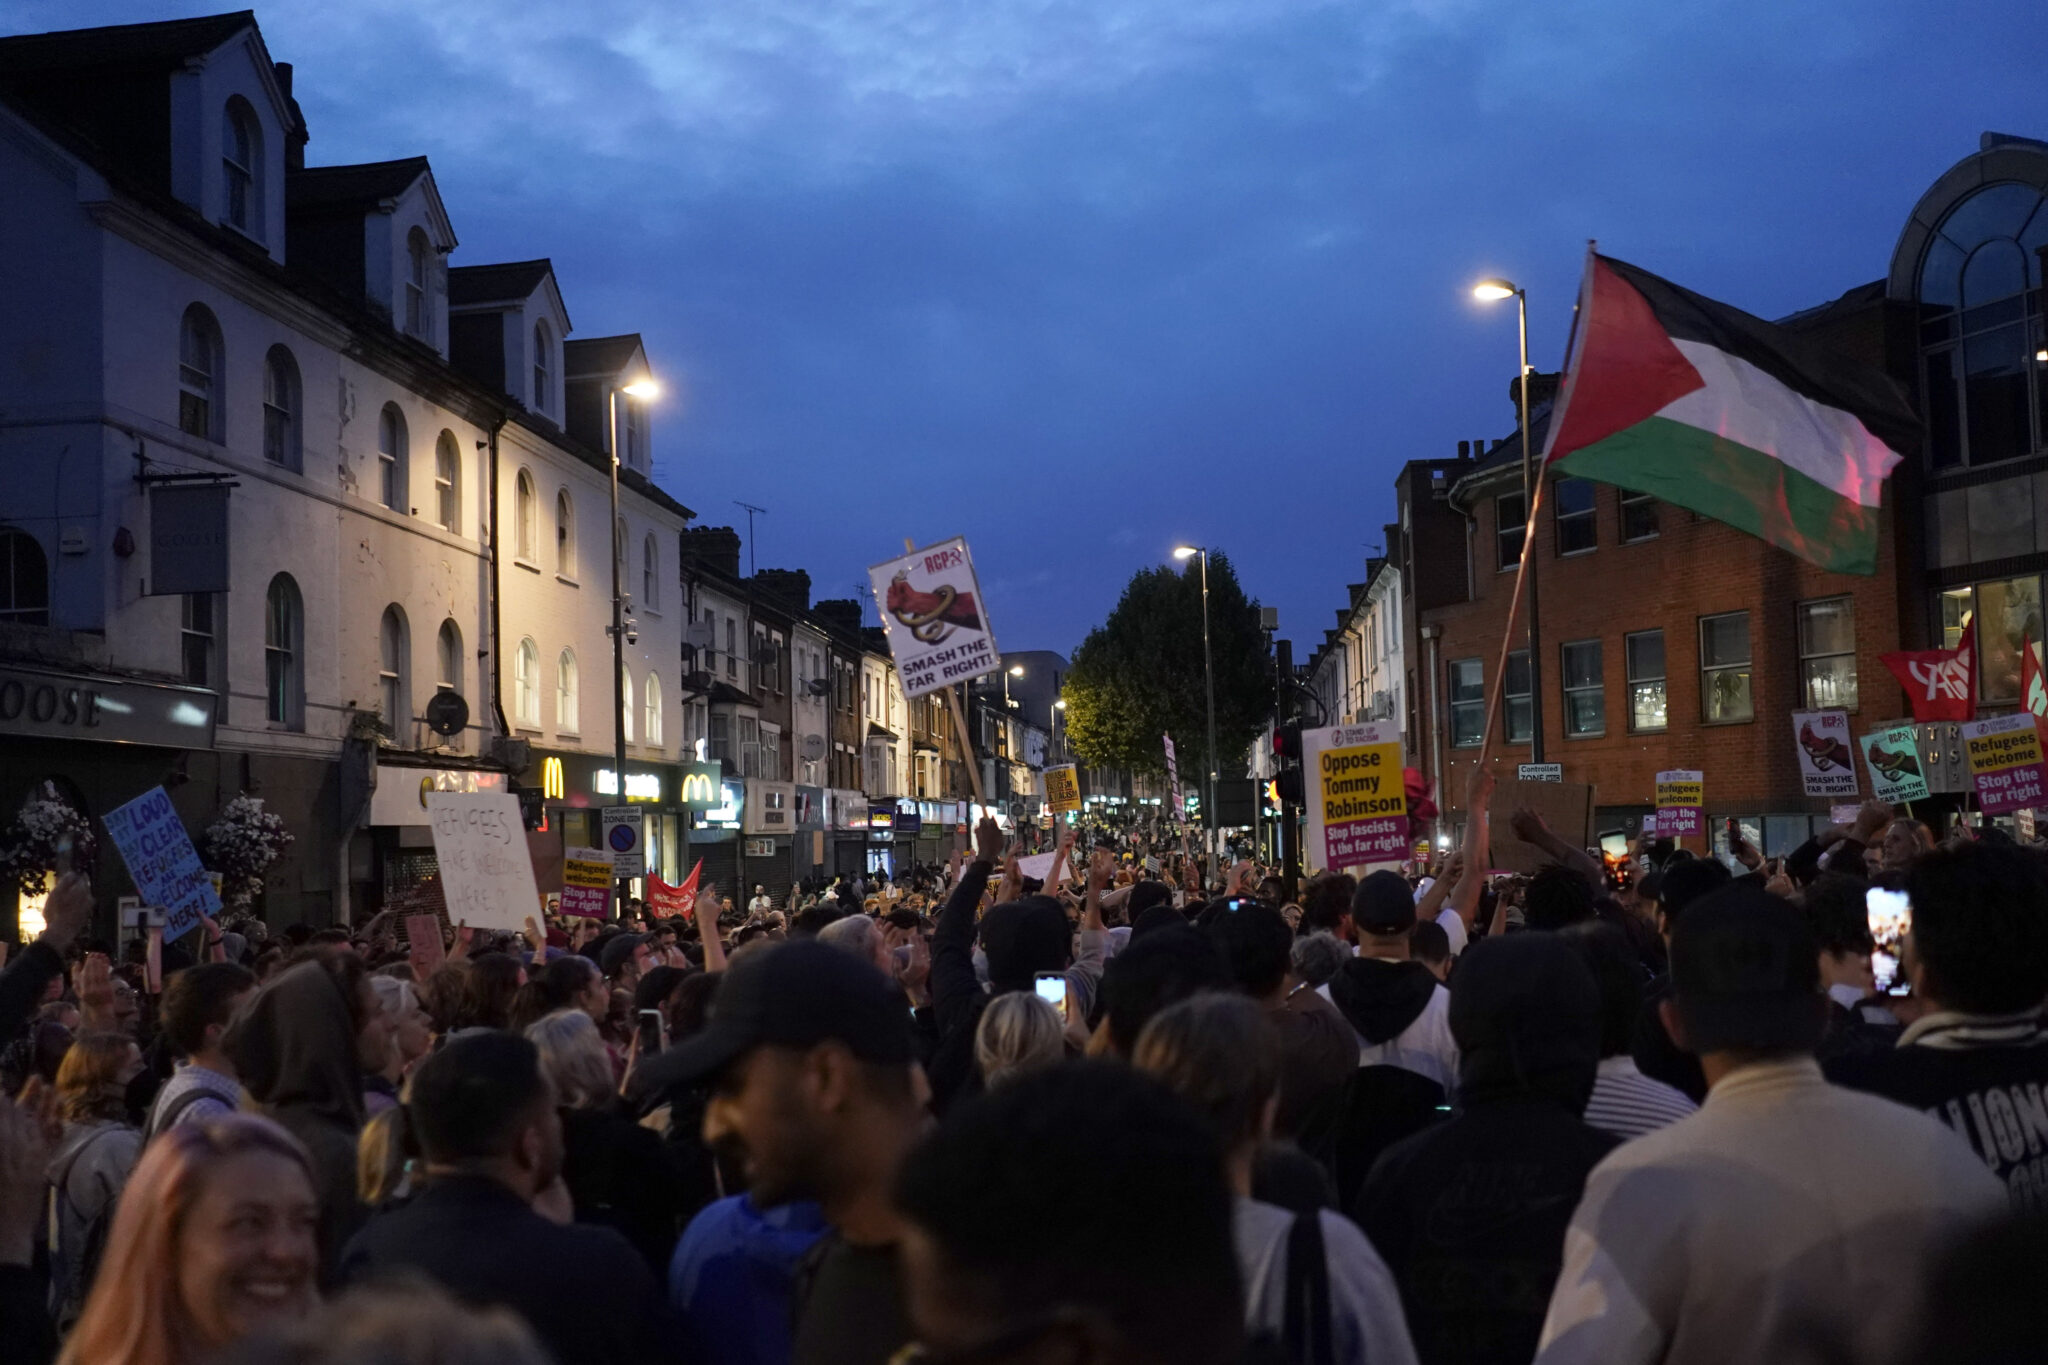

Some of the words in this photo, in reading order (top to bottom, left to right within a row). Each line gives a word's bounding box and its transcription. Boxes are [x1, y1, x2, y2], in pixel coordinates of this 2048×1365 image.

[903, 649, 957, 676] SMASH
[958, 638, 989, 657] THE
[907, 673, 935, 690] FAR
[943, 653, 993, 678] RIGHT!
[1970, 734, 2035, 754] Refugees
[1322, 752, 1380, 775] Oppose
[1974, 750, 2035, 768] welcome
[1324, 776, 1379, 796] Tommy
[1658, 784, 1700, 794] Refugees
[1806, 776, 1834, 784] SMASH
[1836, 775, 1853, 783] THE
[1807, 785, 1821, 793] FAR
[1825, 784, 1856, 793] RIGHT!
[1878, 784, 1906, 795] SMASH
[1907, 781, 1924, 789] THE
[1978, 774, 2012, 789] Stop
[2014, 769, 2039, 783] the
[1658, 795, 1697, 803] welcome
[1899, 789, 1927, 799] RIGHT!
[1981, 791, 2003, 805] far
[2006, 783, 2042, 801] right
[129, 793, 169, 831] LOUD
[1326, 797, 1402, 820] Robinson
[1658, 809, 1677, 819] Stop
[1680, 808, 1696, 818] the
[433, 807, 511, 845] REFUGEES
[603, 815, 625, 823] ZONE
[1658, 820, 1669, 829] far
[1672, 819, 1695, 830] right
[140, 816, 184, 857] CLEAR
[1328, 828, 1348, 841] Stop
[1351, 821, 1396, 836] fascists
[1329, 844, 1336, 857] &
[1338, 841, 1353, 855] the
[1355, 839, 1372, 852] far
[1375, 835, 1405, 851] right
[135, 838, 193, 887] REFUGEES
[567, 861, 610, 874] Refugees
[566, 874, 607, 885] welcome
[564, 887, 586, 899] Stop
[588, 889, 604, 899] the
[168, 894, 209, 932] HERE!
[563, 898, 576, 908] far
[579, 900, 602, 912] right
